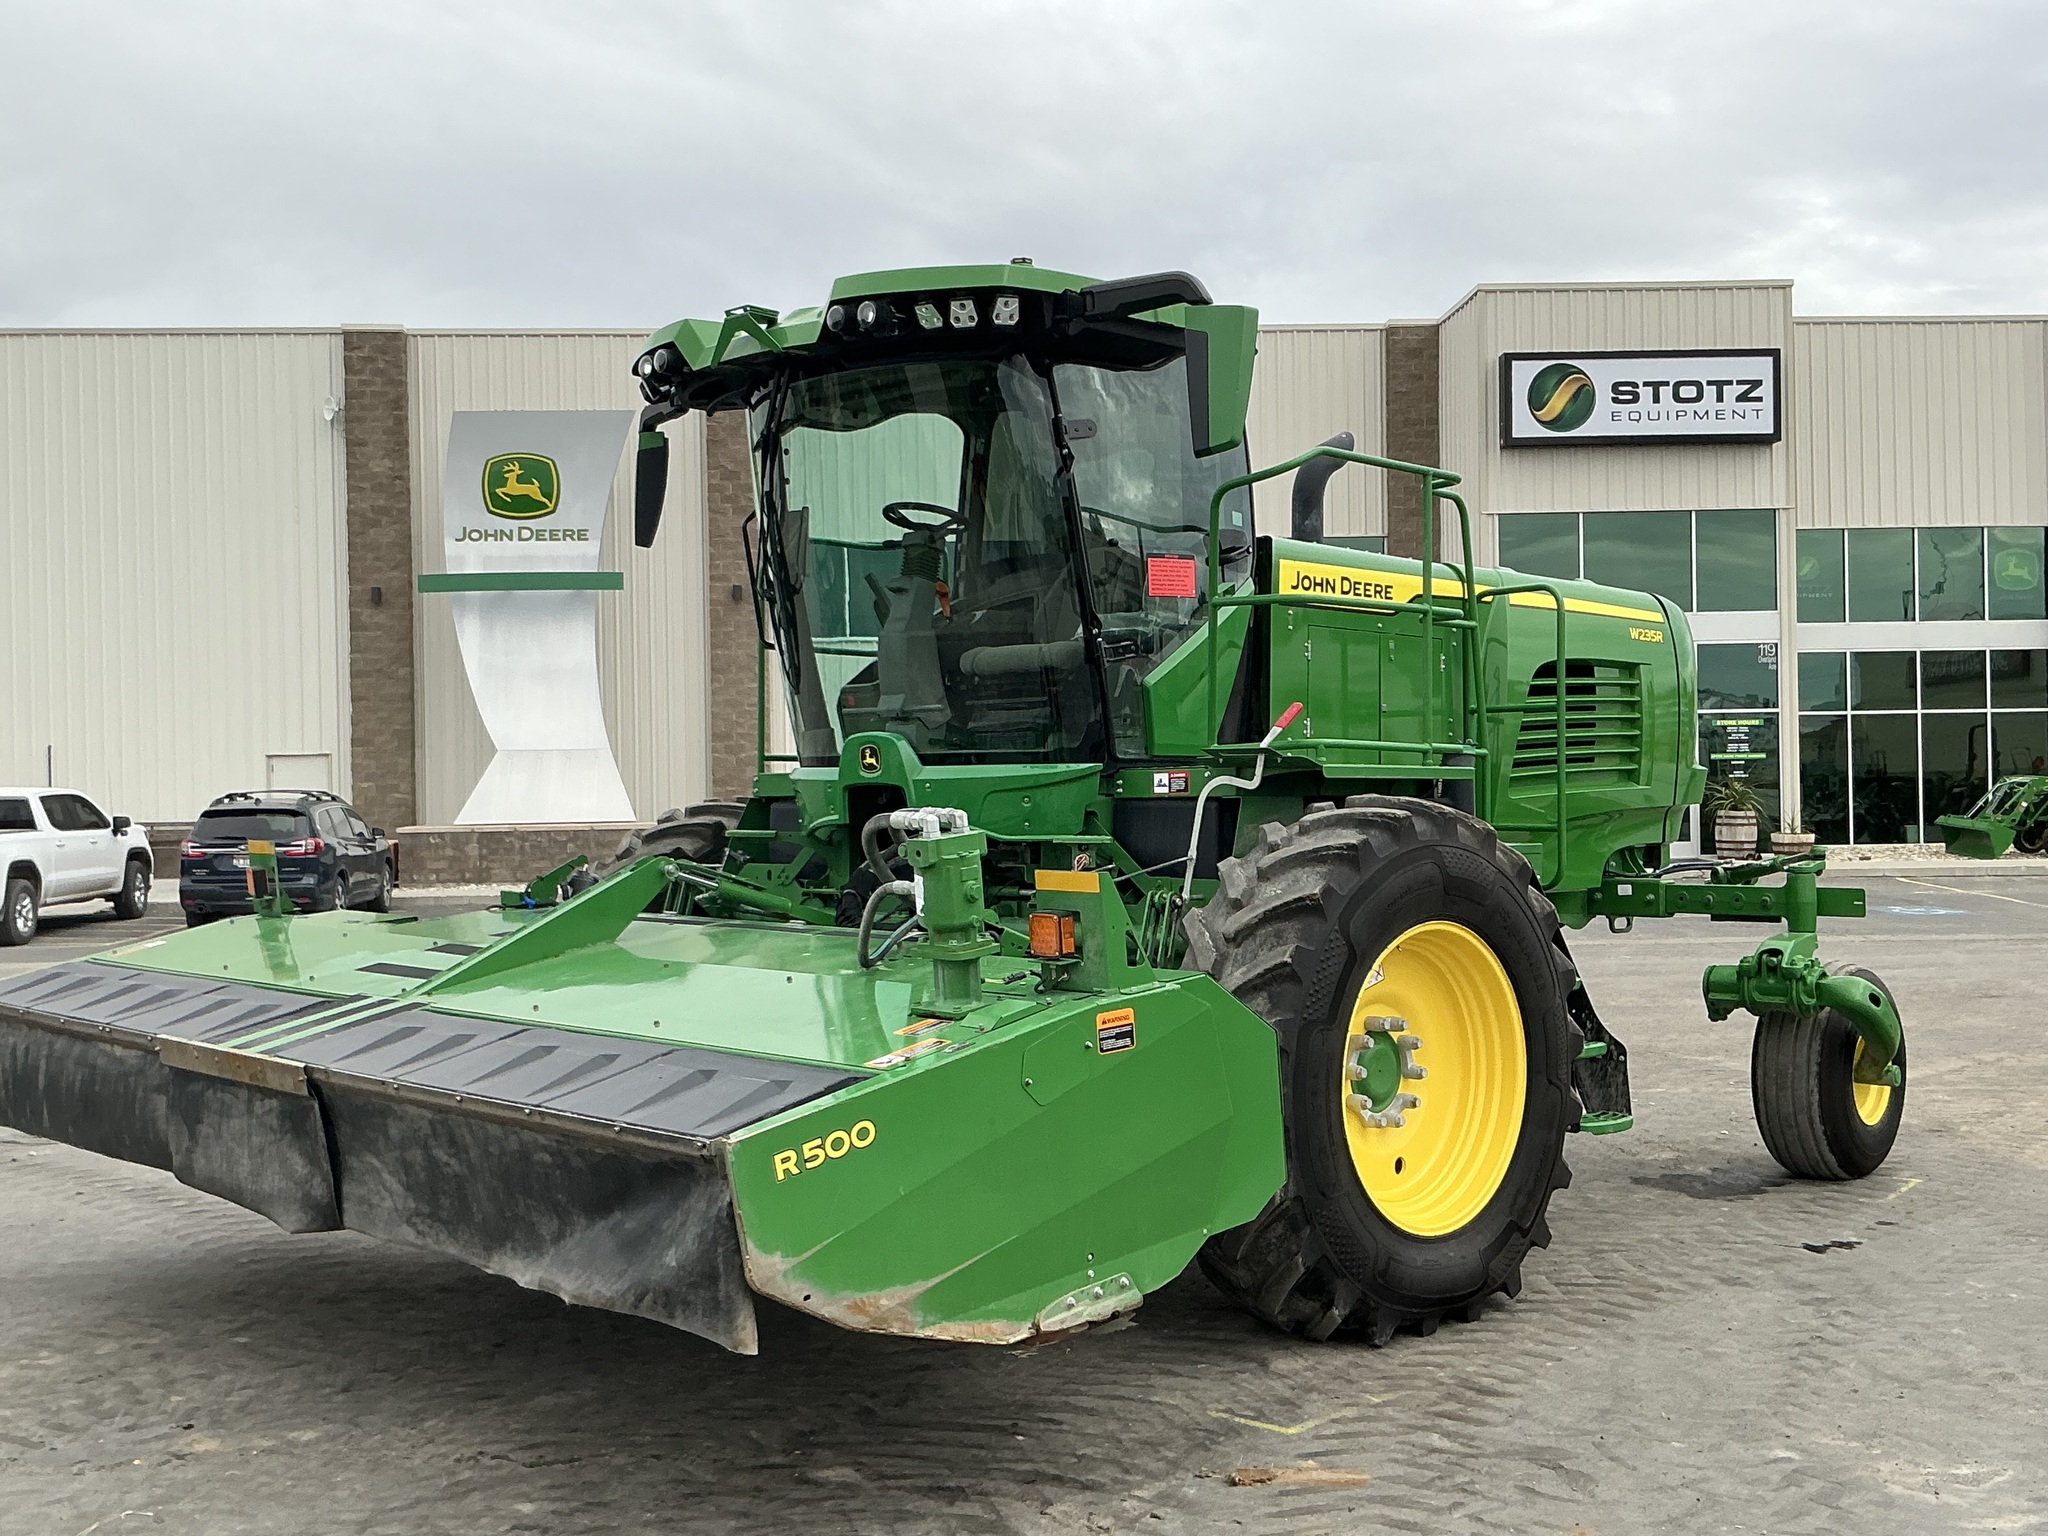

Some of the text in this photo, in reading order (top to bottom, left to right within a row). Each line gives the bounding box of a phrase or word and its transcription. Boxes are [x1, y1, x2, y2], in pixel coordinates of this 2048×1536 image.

[1611, 379, 1764, 405] STOTZ
[1611, 408, 1764, 423] EQUIPMENT
[455, 526, 590, 542] JOHN DEERE
[1291, 570, 1393, 600] JOHN DEERE
[1629, 626, 1664, 643] W235R
[1757, 643, 1776, 656] 119
[1106, 1014, 1130, 1023] WARNING
